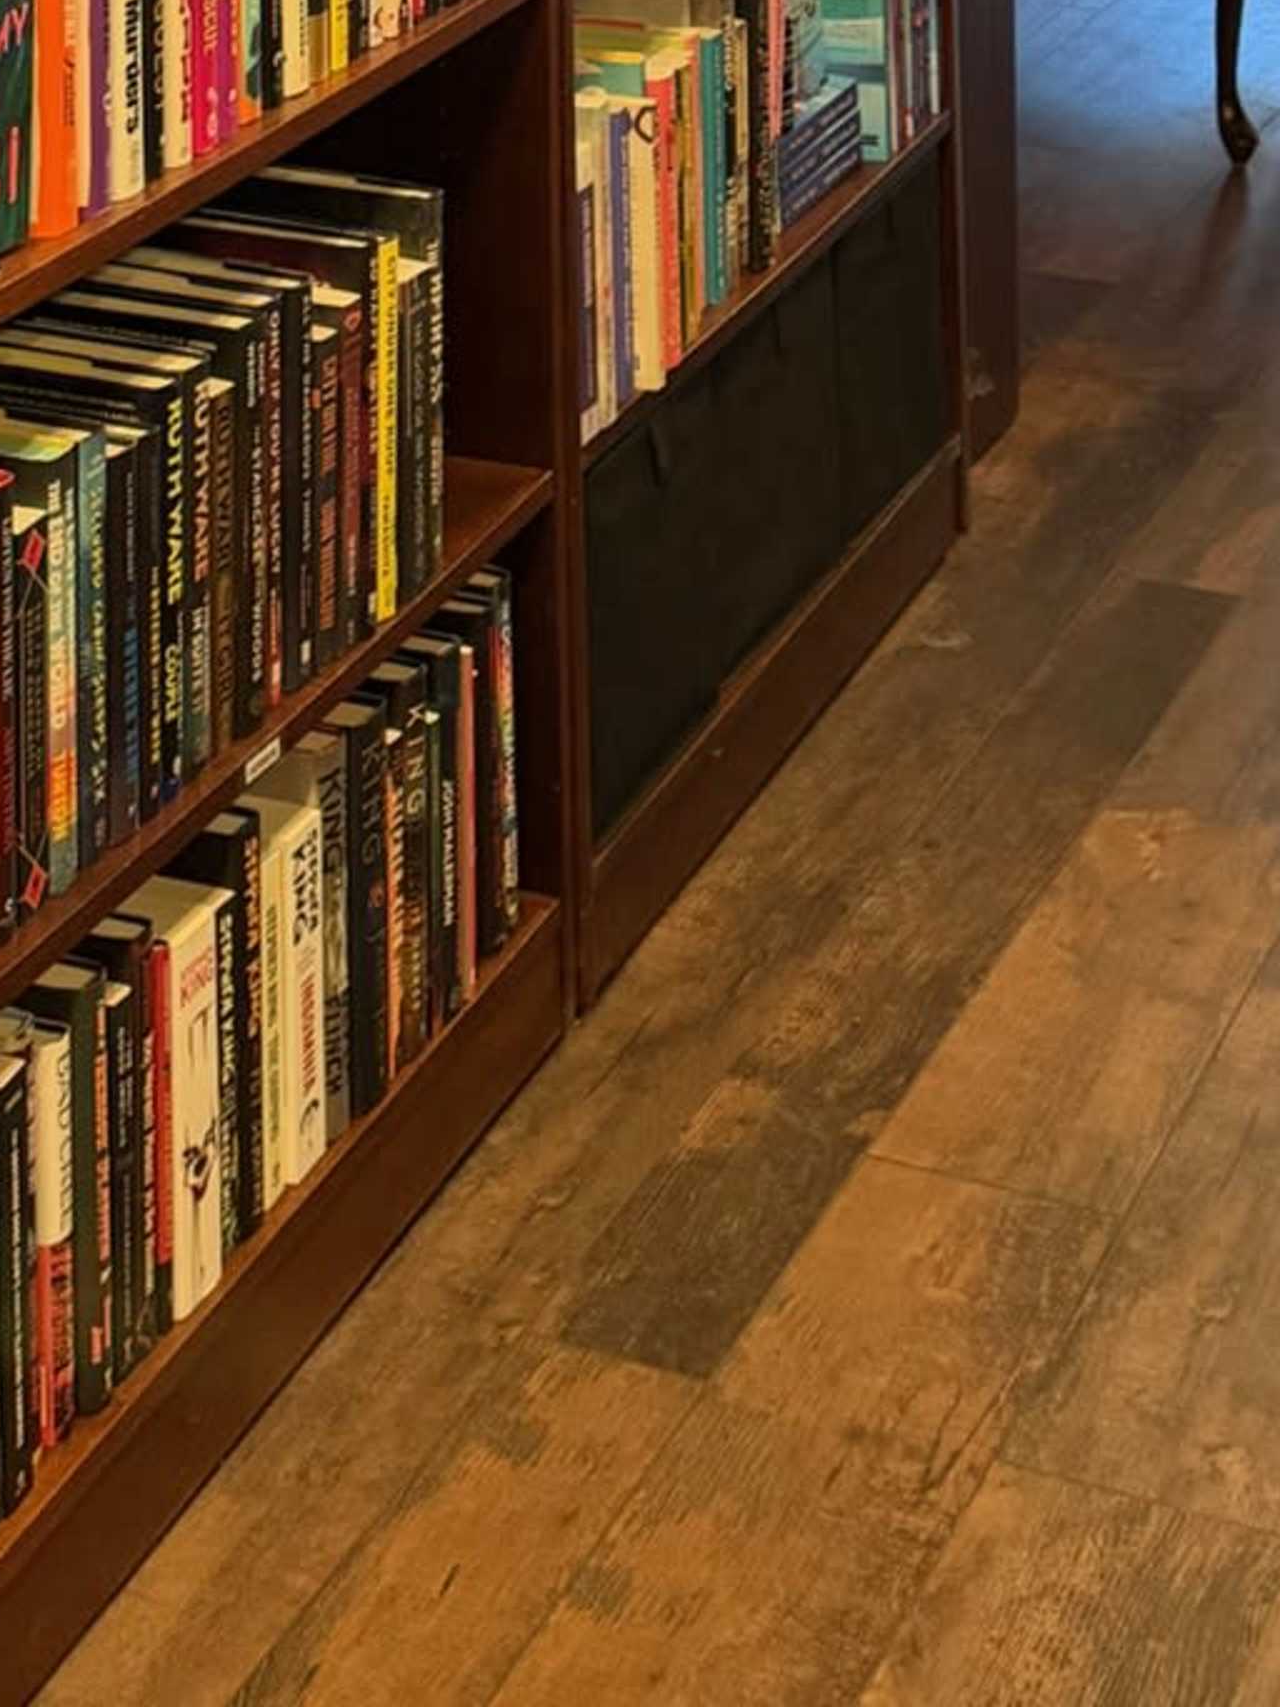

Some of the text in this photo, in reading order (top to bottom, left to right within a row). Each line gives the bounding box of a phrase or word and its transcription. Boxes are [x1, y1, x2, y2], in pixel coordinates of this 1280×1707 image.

[166, 397, 185, 606] RUTH WARE
[193, 382, 211, 583] RUTH WARE
[48, 516, 69, 731] END WORLD
[321, 768, 347, 878] KING
[406, 702, 426, 817] KING
[290, 844, 307, 945] KING
[442, 778, 456, 926] JOSH MALERMAN
[217, 910, 237, 1084] STEPHEN KING
